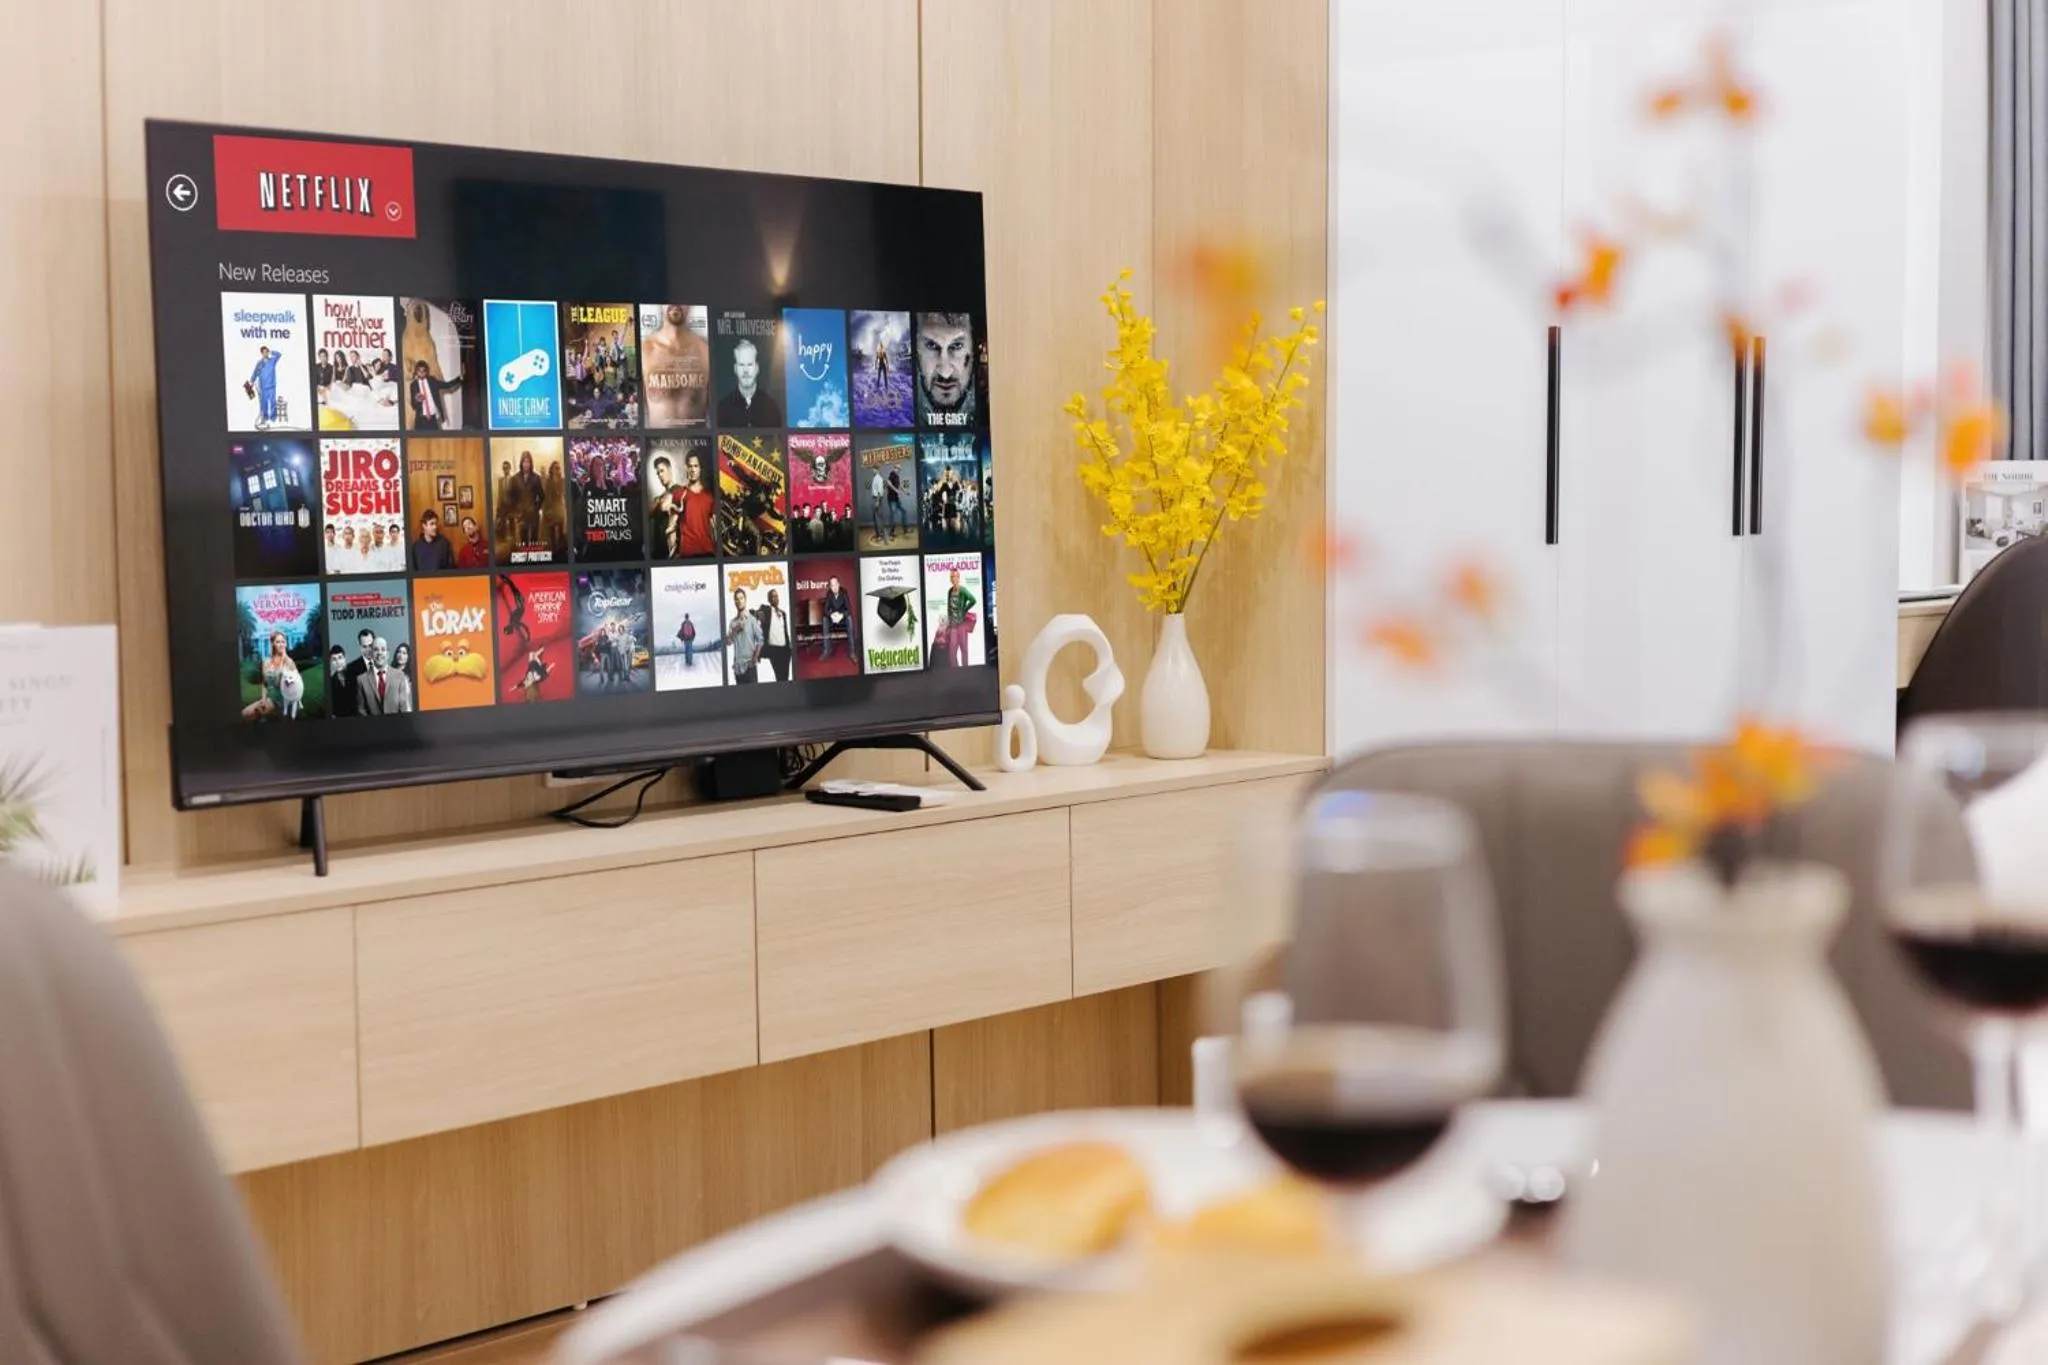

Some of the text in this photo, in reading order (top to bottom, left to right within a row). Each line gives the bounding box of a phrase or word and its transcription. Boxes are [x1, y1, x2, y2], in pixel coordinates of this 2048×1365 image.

[259, 172, 373, 215] NETFLIX
[218, 262, 330, 284] New Releases
[233, 309, 296, 325] sleepwalk
[324, 298, 353, 318] how
[579, 306, 629, 324] LEAGUE
[240, 326, 291, 339] with me
[336, 314, 385, 333] met your
[717, 318, 735, 335] MR.
[736, 318, 777, 336] UNIVERSE
[323, 330, 387, 349] mother
[798, 333, 832, 364] happy
[649, 373, 706, 390] MANSOME
[498, 397, 551, 416] INDIE GAME
[927, 412, 968, 426] THE GREY
[323, 449, 400, 480] JIRO
[324, 479, 400, 493] DREAMS OF
[326, 491, 400, 516] SUSHI
[587, 498, 628, 513] SMART
[239, 511, 295, 528] DOCTOR WHO
[587, 512, 628, 528] LAUGHS
[926, 560, 980, 573] YOUNG ADULT
[728, 565, 785, 592] psych
[796, 579, 829, 590] bill burr
[528, 590, 567, 603] AMERICAN
[330, 605, 405, 621] TODD MARGARET
[421, 605, 486, 637] LORAX
[867, 646, 920, 669] Vegucated
